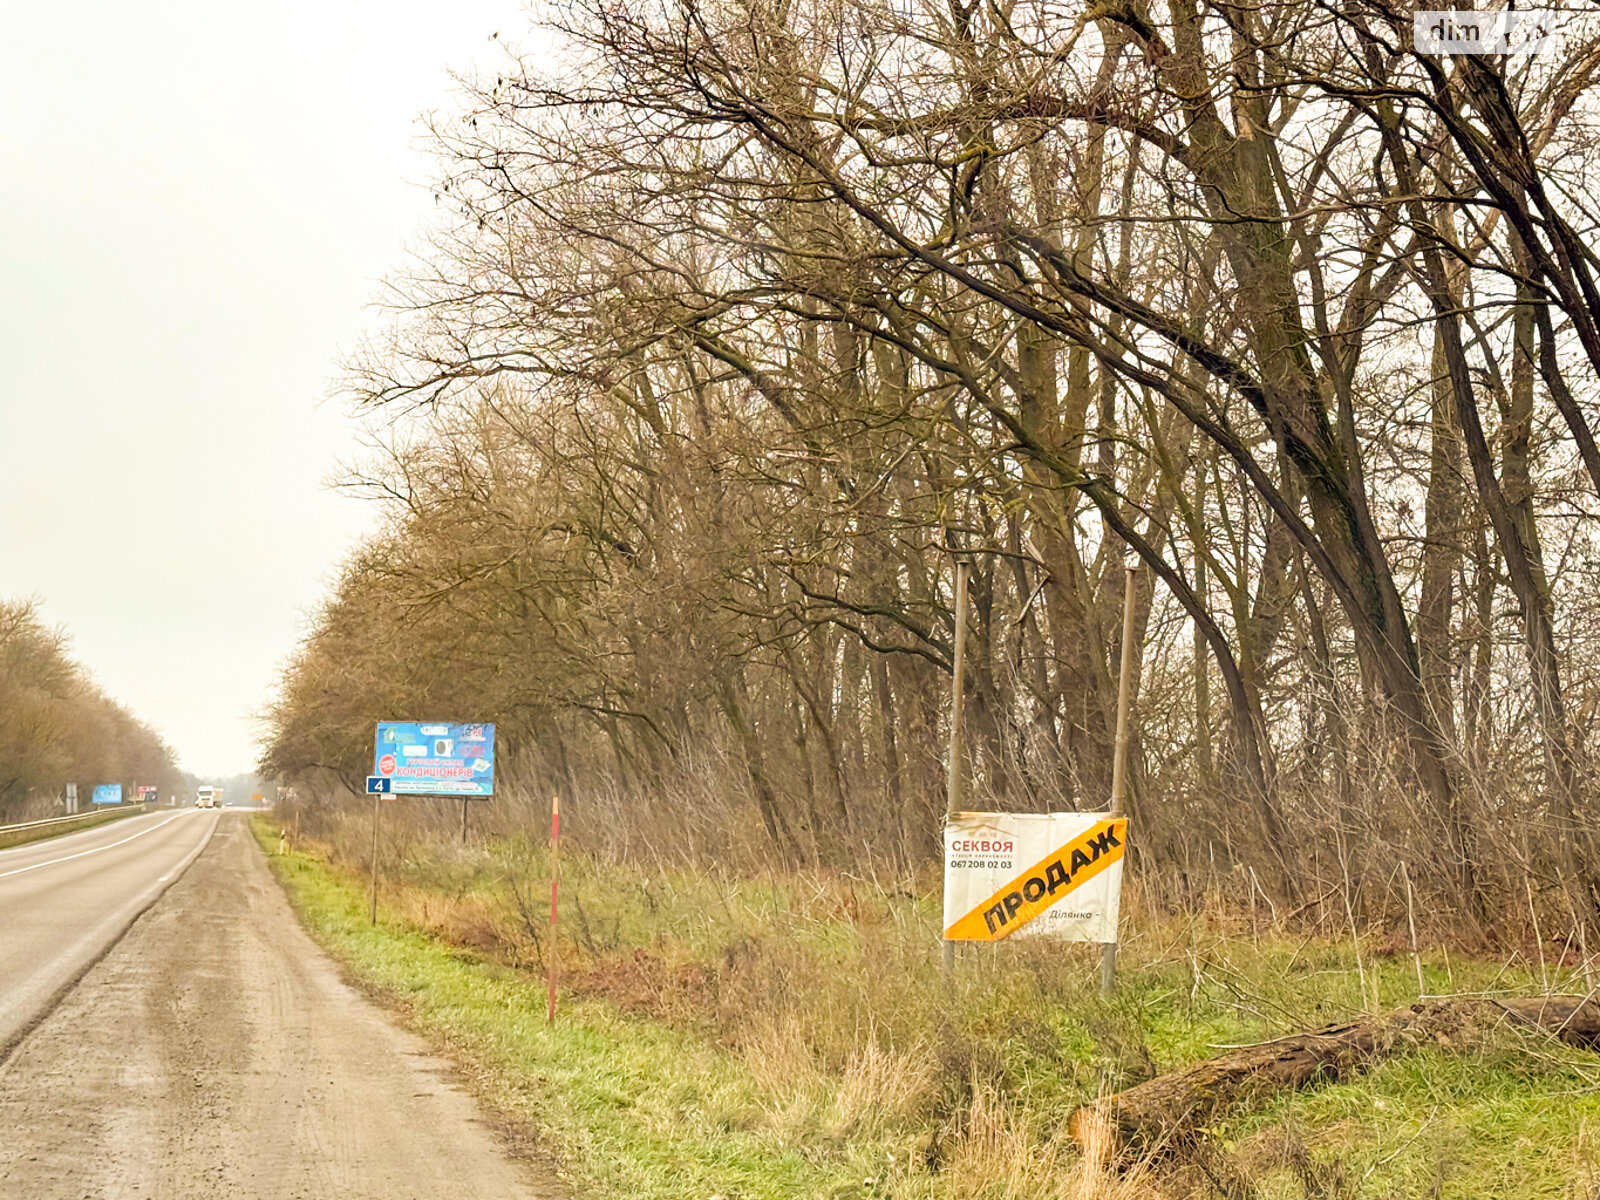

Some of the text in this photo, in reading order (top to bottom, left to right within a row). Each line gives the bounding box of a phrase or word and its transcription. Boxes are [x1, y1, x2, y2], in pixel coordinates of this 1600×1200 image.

[396, 767, 474, 777] КОНДИЦІОНЕРІВ
[374, 780, 384, 792] 4
[952, 840, 1013, 853] СЕКВОЯ
[951, 860, 1012, 869] 067 208 02 03
[983, 824, 1121, 936] ПРОДАЖ
[1049, 909, 1092, 920] Ділянка
